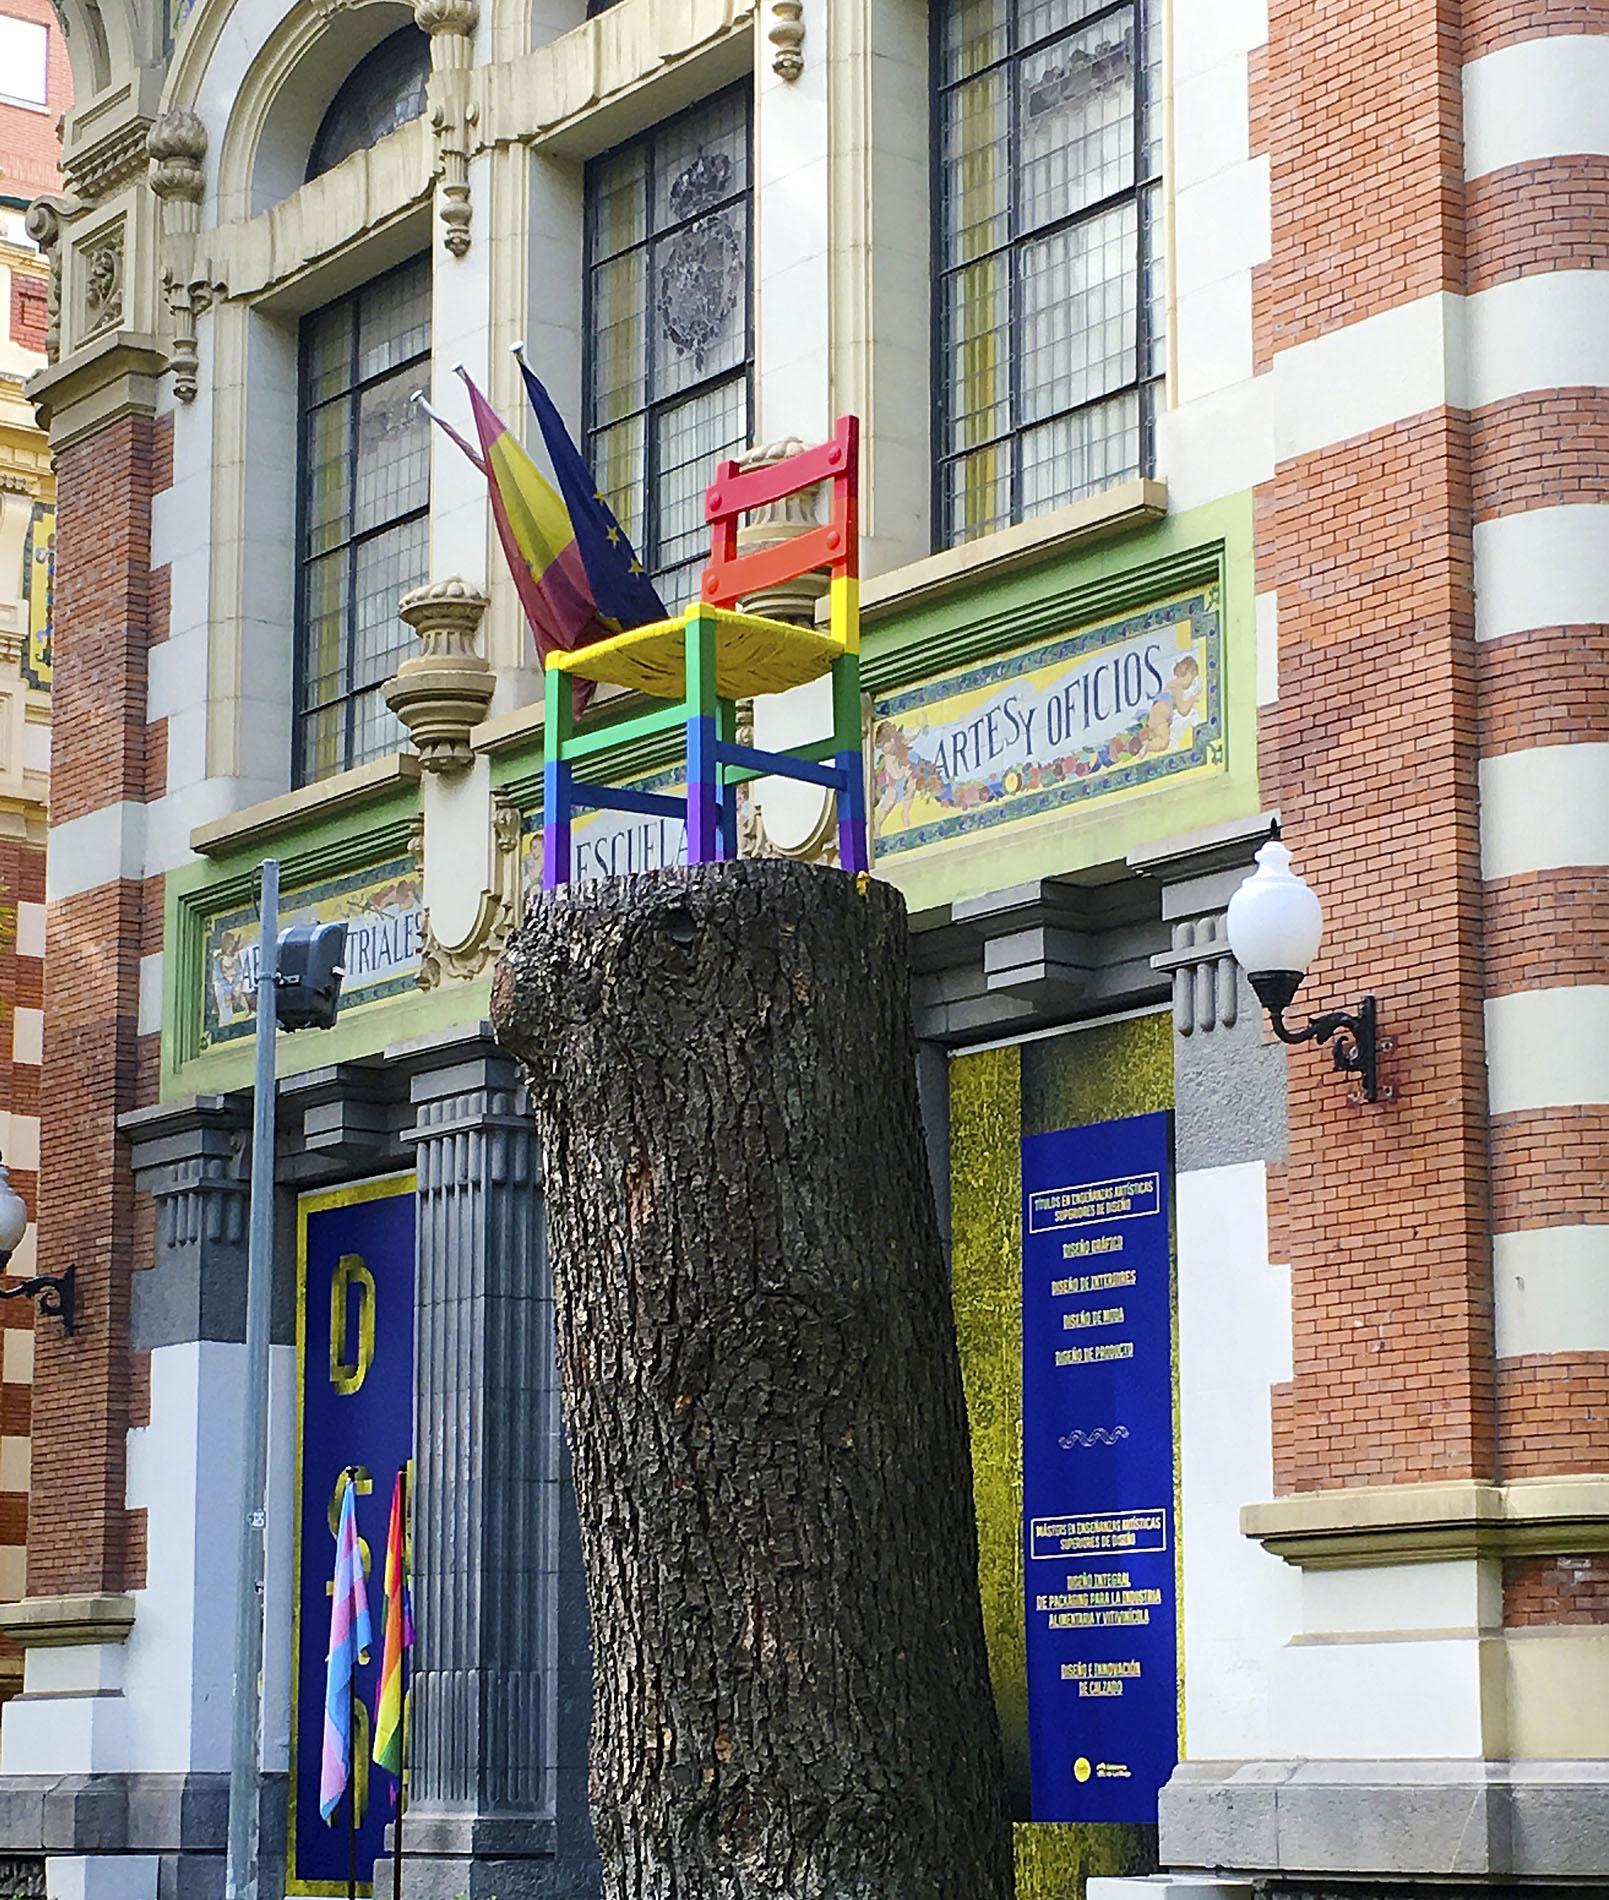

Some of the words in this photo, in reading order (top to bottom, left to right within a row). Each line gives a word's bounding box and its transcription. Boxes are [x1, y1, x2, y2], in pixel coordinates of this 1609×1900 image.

[935, 696, 1020, 780] ARTES
[1018, 707, 1038, 756] Y
[1047, 644, 1163, 746] OFICIOS
[576, 818, 688, 882] ESCUELA
[1062, 1238, 1090, 1259] DISEÑO
[1052, 1276, 1079, 1297] DISEÑO
[1080, 1276, 1090, 1292] DE
[1091, 1269, 1137, 1290] INTERIORES
[1063, 1309, 1091, 1330] DISEÑO
[1092, 1310, 1102, 1326] DE
[1055, 1346, 1082, 1367] DISEÑO
[1083, 1347, 1094, 1363] DE
[1067, 1572, 1093, 1591] DISEÑO
[1061, 1661, 1087, 1680] DISEÑO
[1079, 1681, 1088, 1697] DE
[1089, 1680, 1123, 1696] CALZADO
